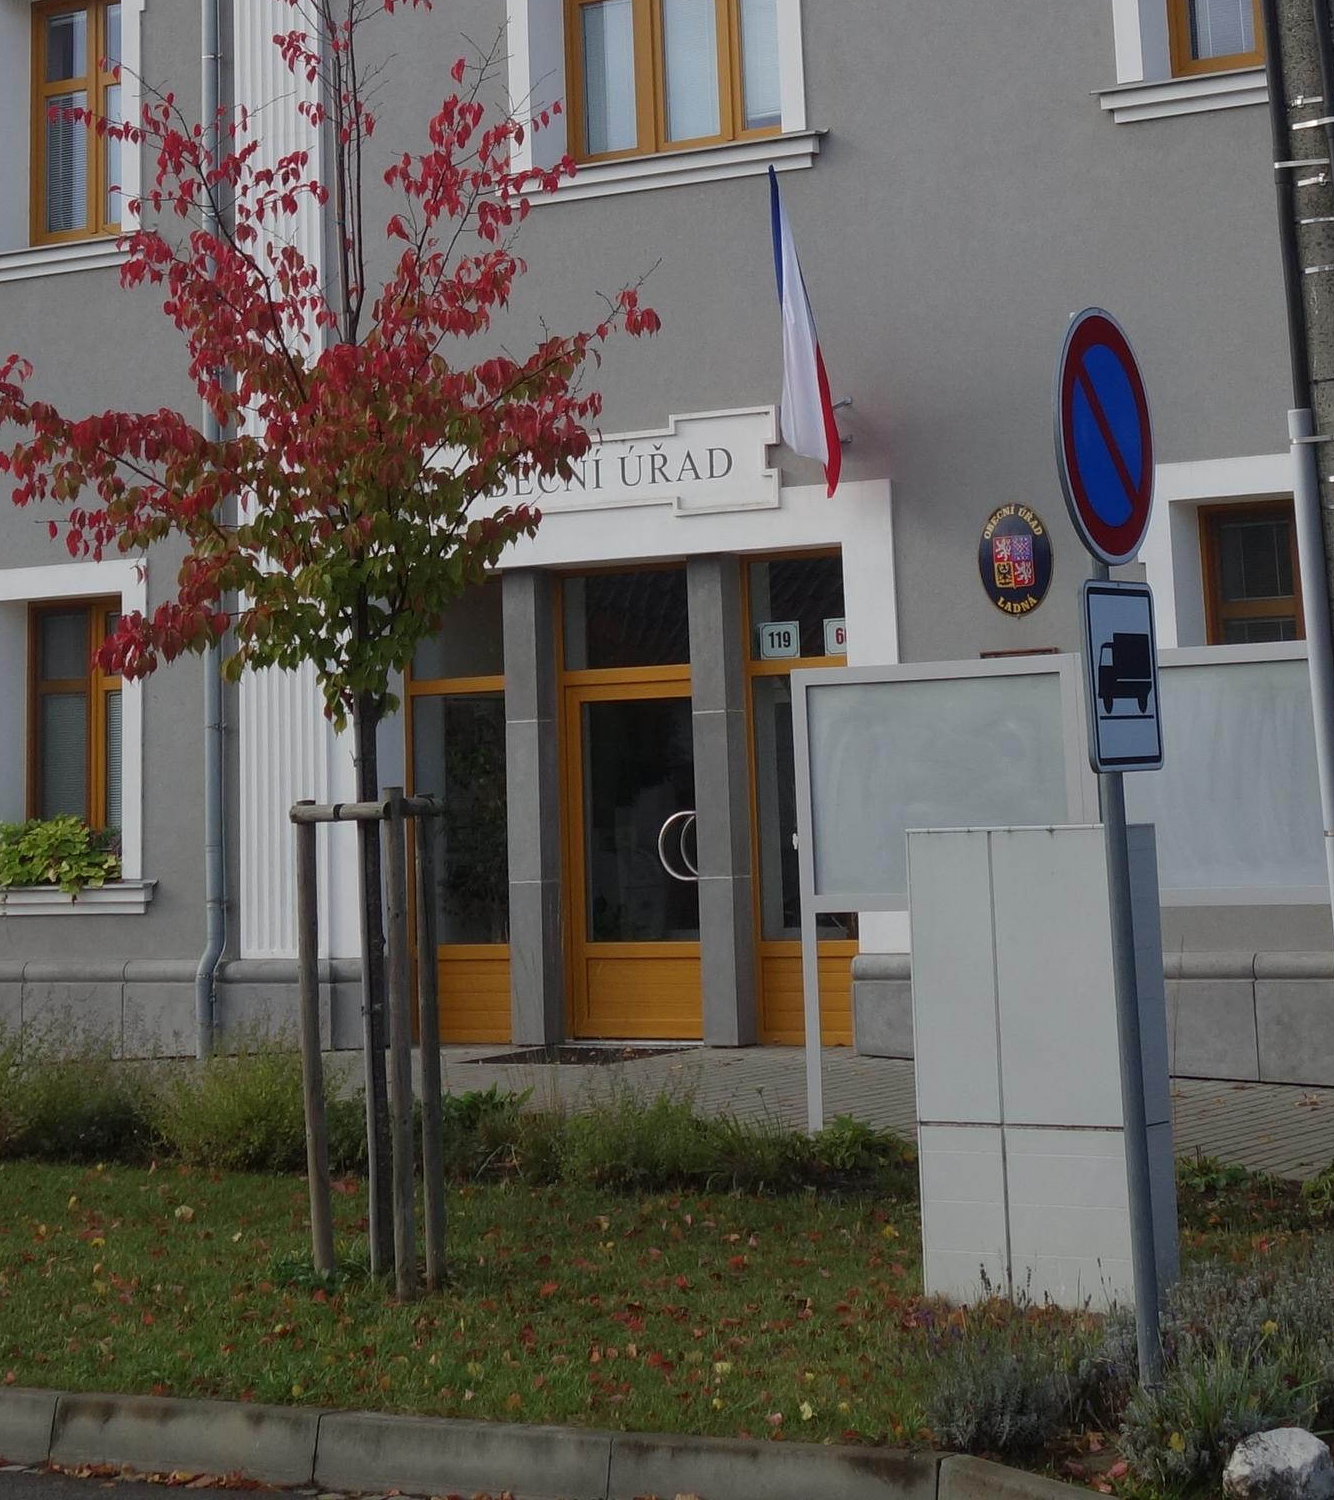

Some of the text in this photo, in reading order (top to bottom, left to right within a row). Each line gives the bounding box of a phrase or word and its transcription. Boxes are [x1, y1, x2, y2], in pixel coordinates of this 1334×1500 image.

[487, 443, 734, 498] BECNÍ ÚŘAD
[983, 505, 1043, 539] OBECNÍ ÚŘAD
[997, 593, 1037, 613] LADNÁ
[768, 631, 791, 649] 119
[835, 627, 847, 645] 6
